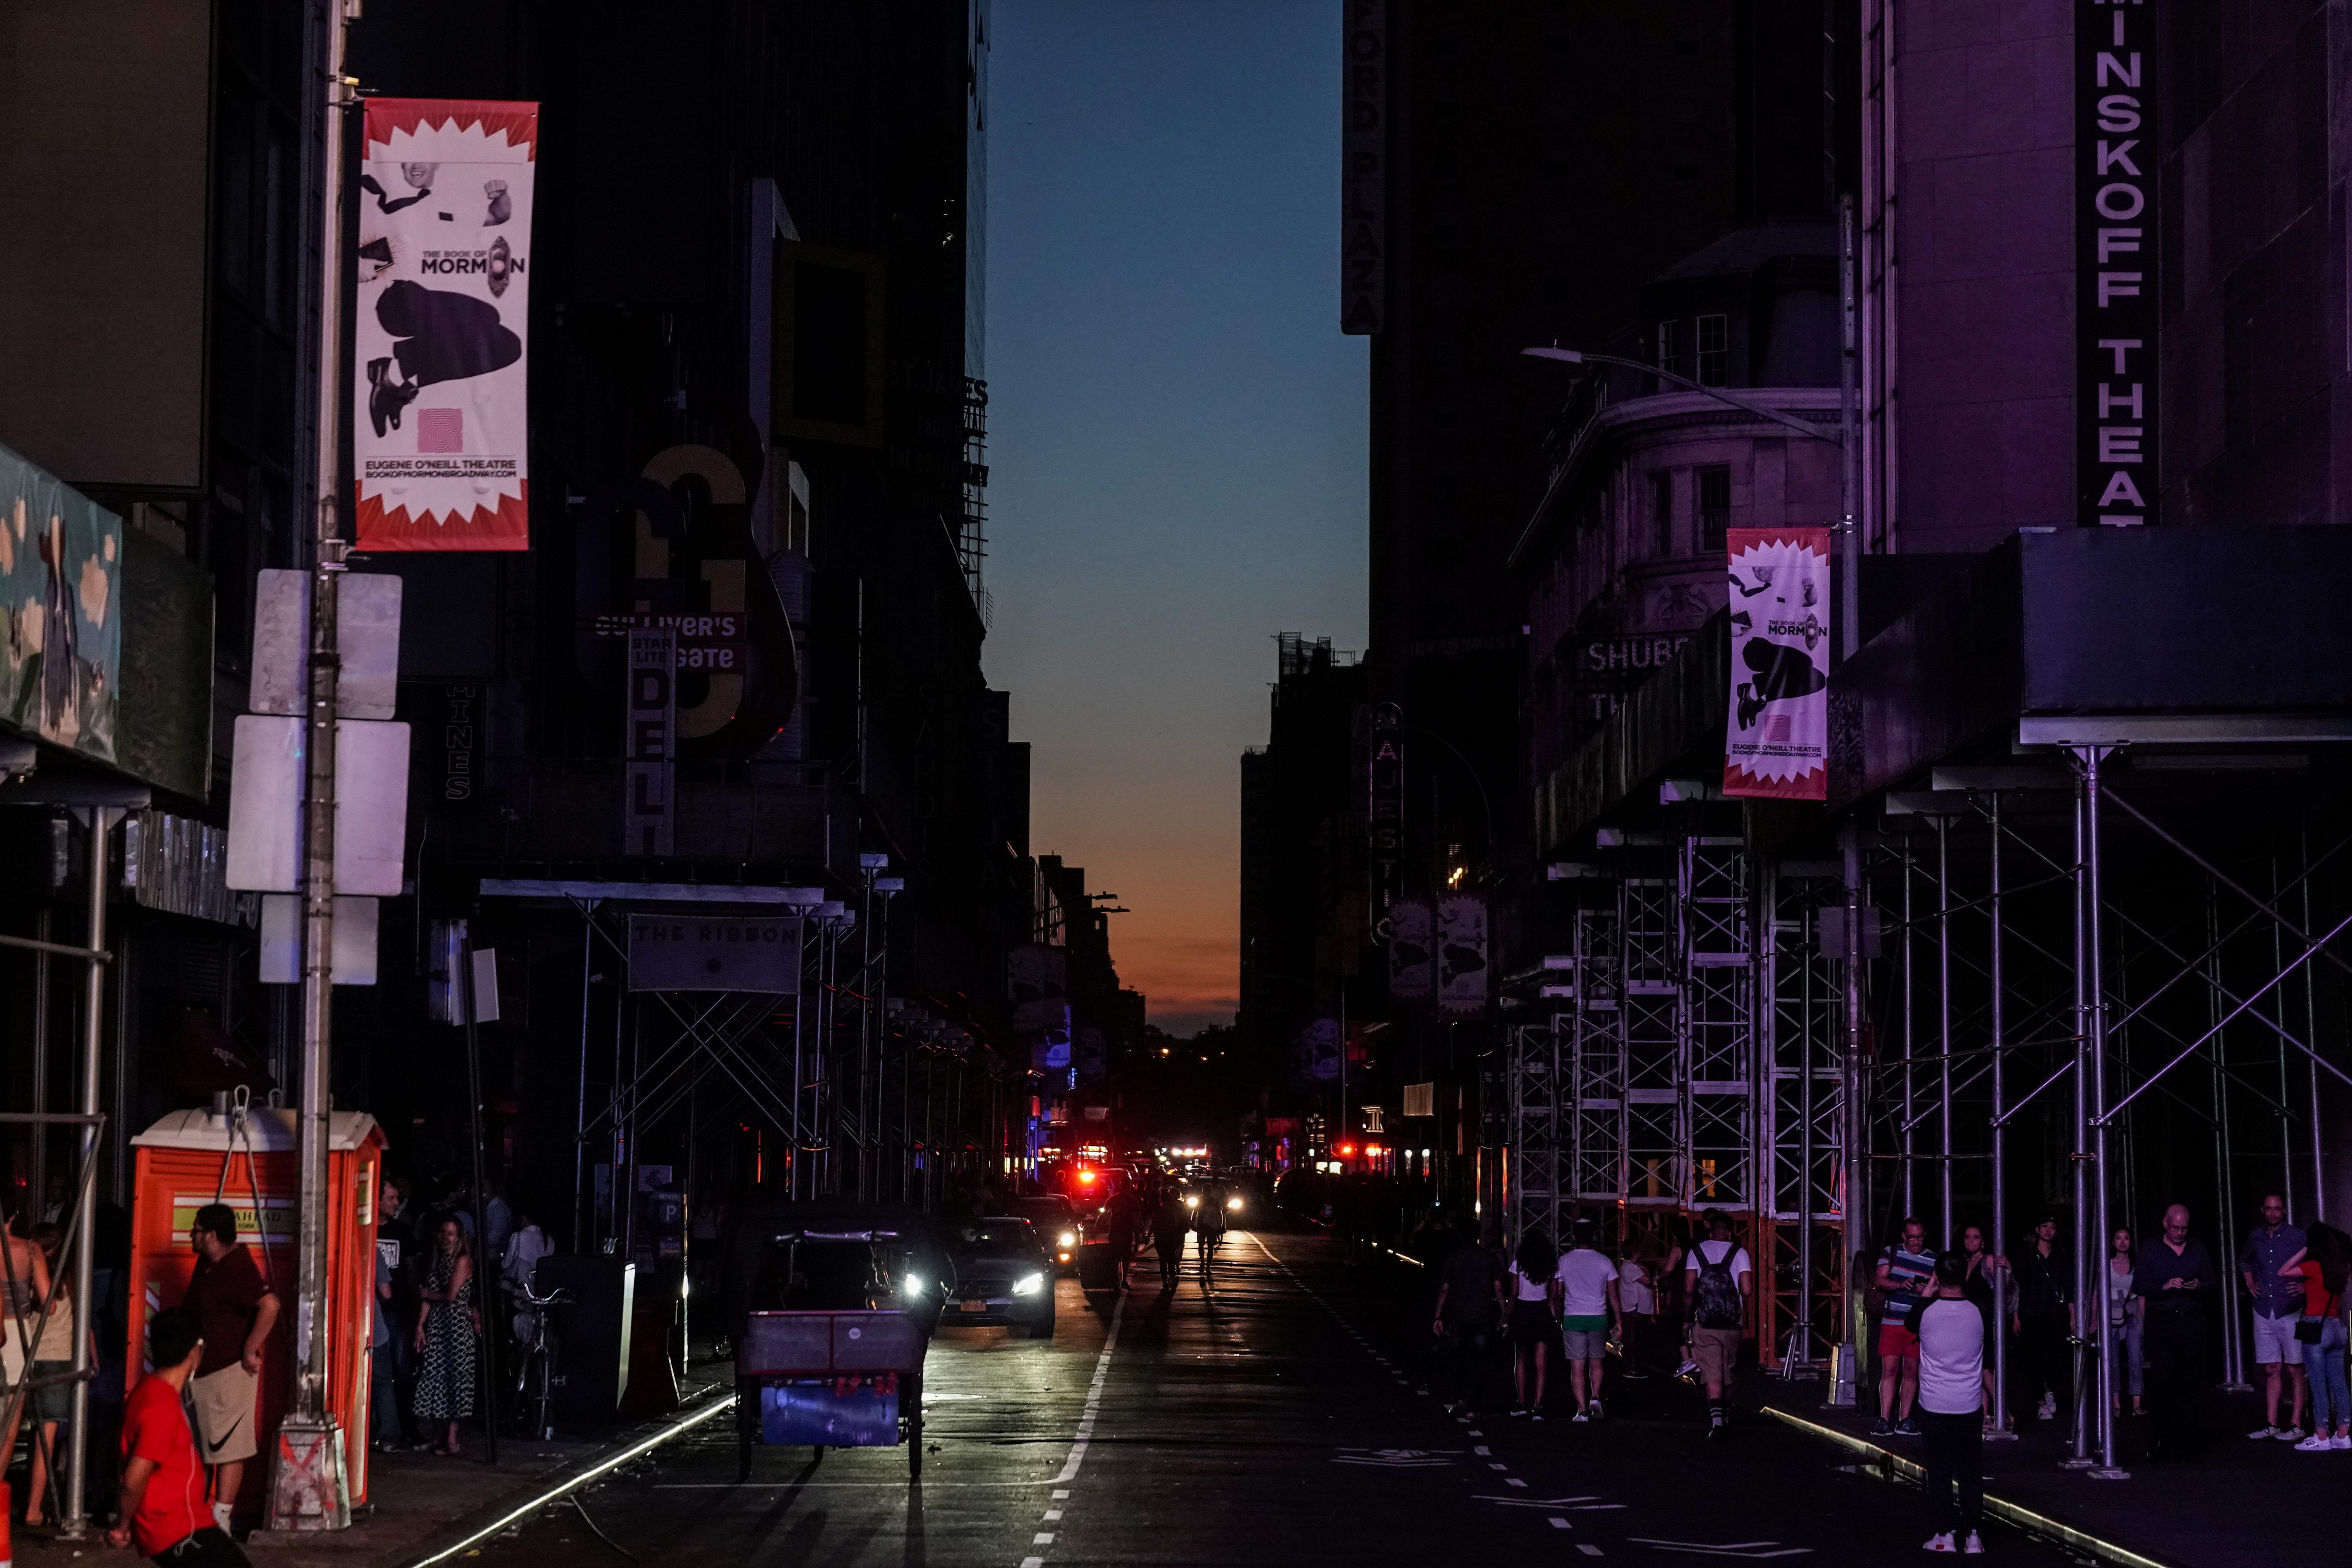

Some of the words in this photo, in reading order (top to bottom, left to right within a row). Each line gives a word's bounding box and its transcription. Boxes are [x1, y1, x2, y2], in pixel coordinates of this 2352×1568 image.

[2094, 0, 2145, 308] INSKOFF
[366, 460, 413, 469] EUGENE
[415, 460, 461, 469] O'NEILL
[462, 460, 517, 469] THEATRE
[632, 638, 671, 649] STAR
[636, 651, 667, 662] LITE
[633, 668, 670, 856] DELI
[636, 925, 683, 941] THE
[699, 926, 795, 944] RIBBON
